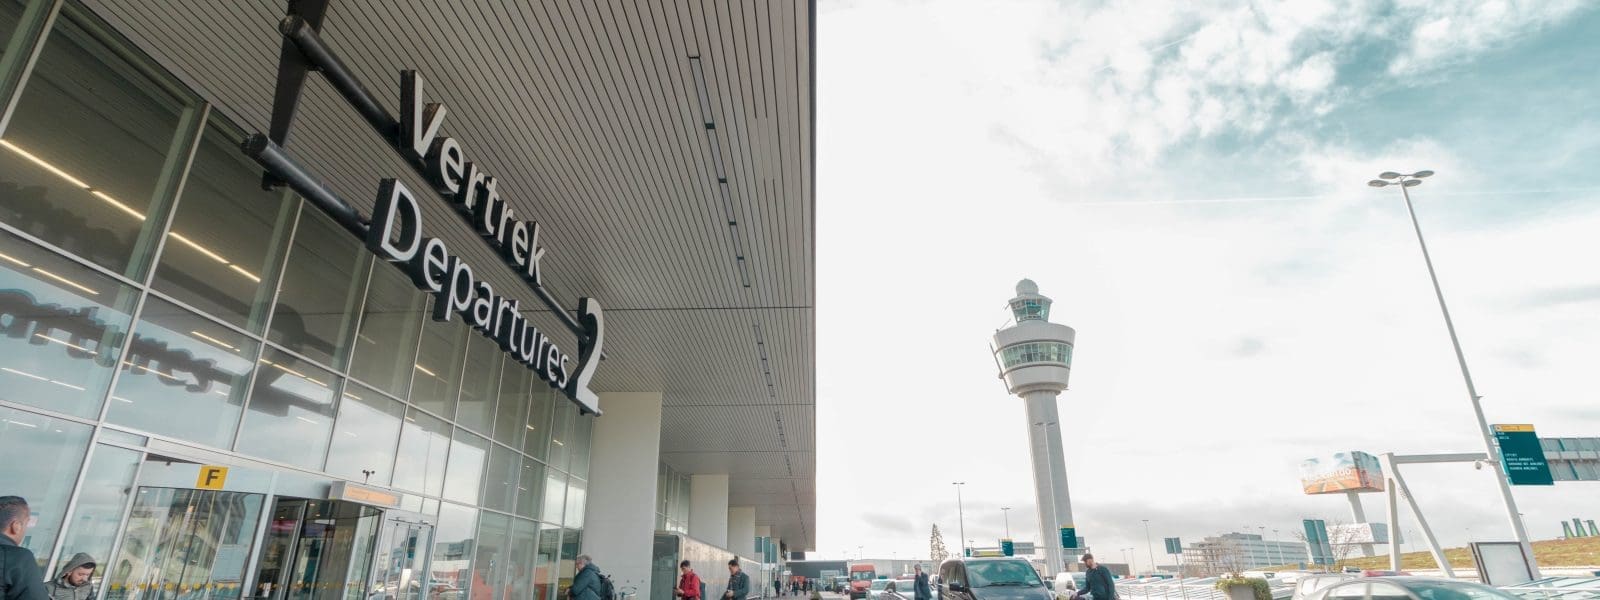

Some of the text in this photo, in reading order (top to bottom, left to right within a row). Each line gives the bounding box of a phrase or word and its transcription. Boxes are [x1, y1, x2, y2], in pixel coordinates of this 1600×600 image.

[412, 71, 546, 287] Vertrek
[379, 178, 570, 390] Departures
[575, 297, 605, 414] 2
[205, 469, 220, 486] F
